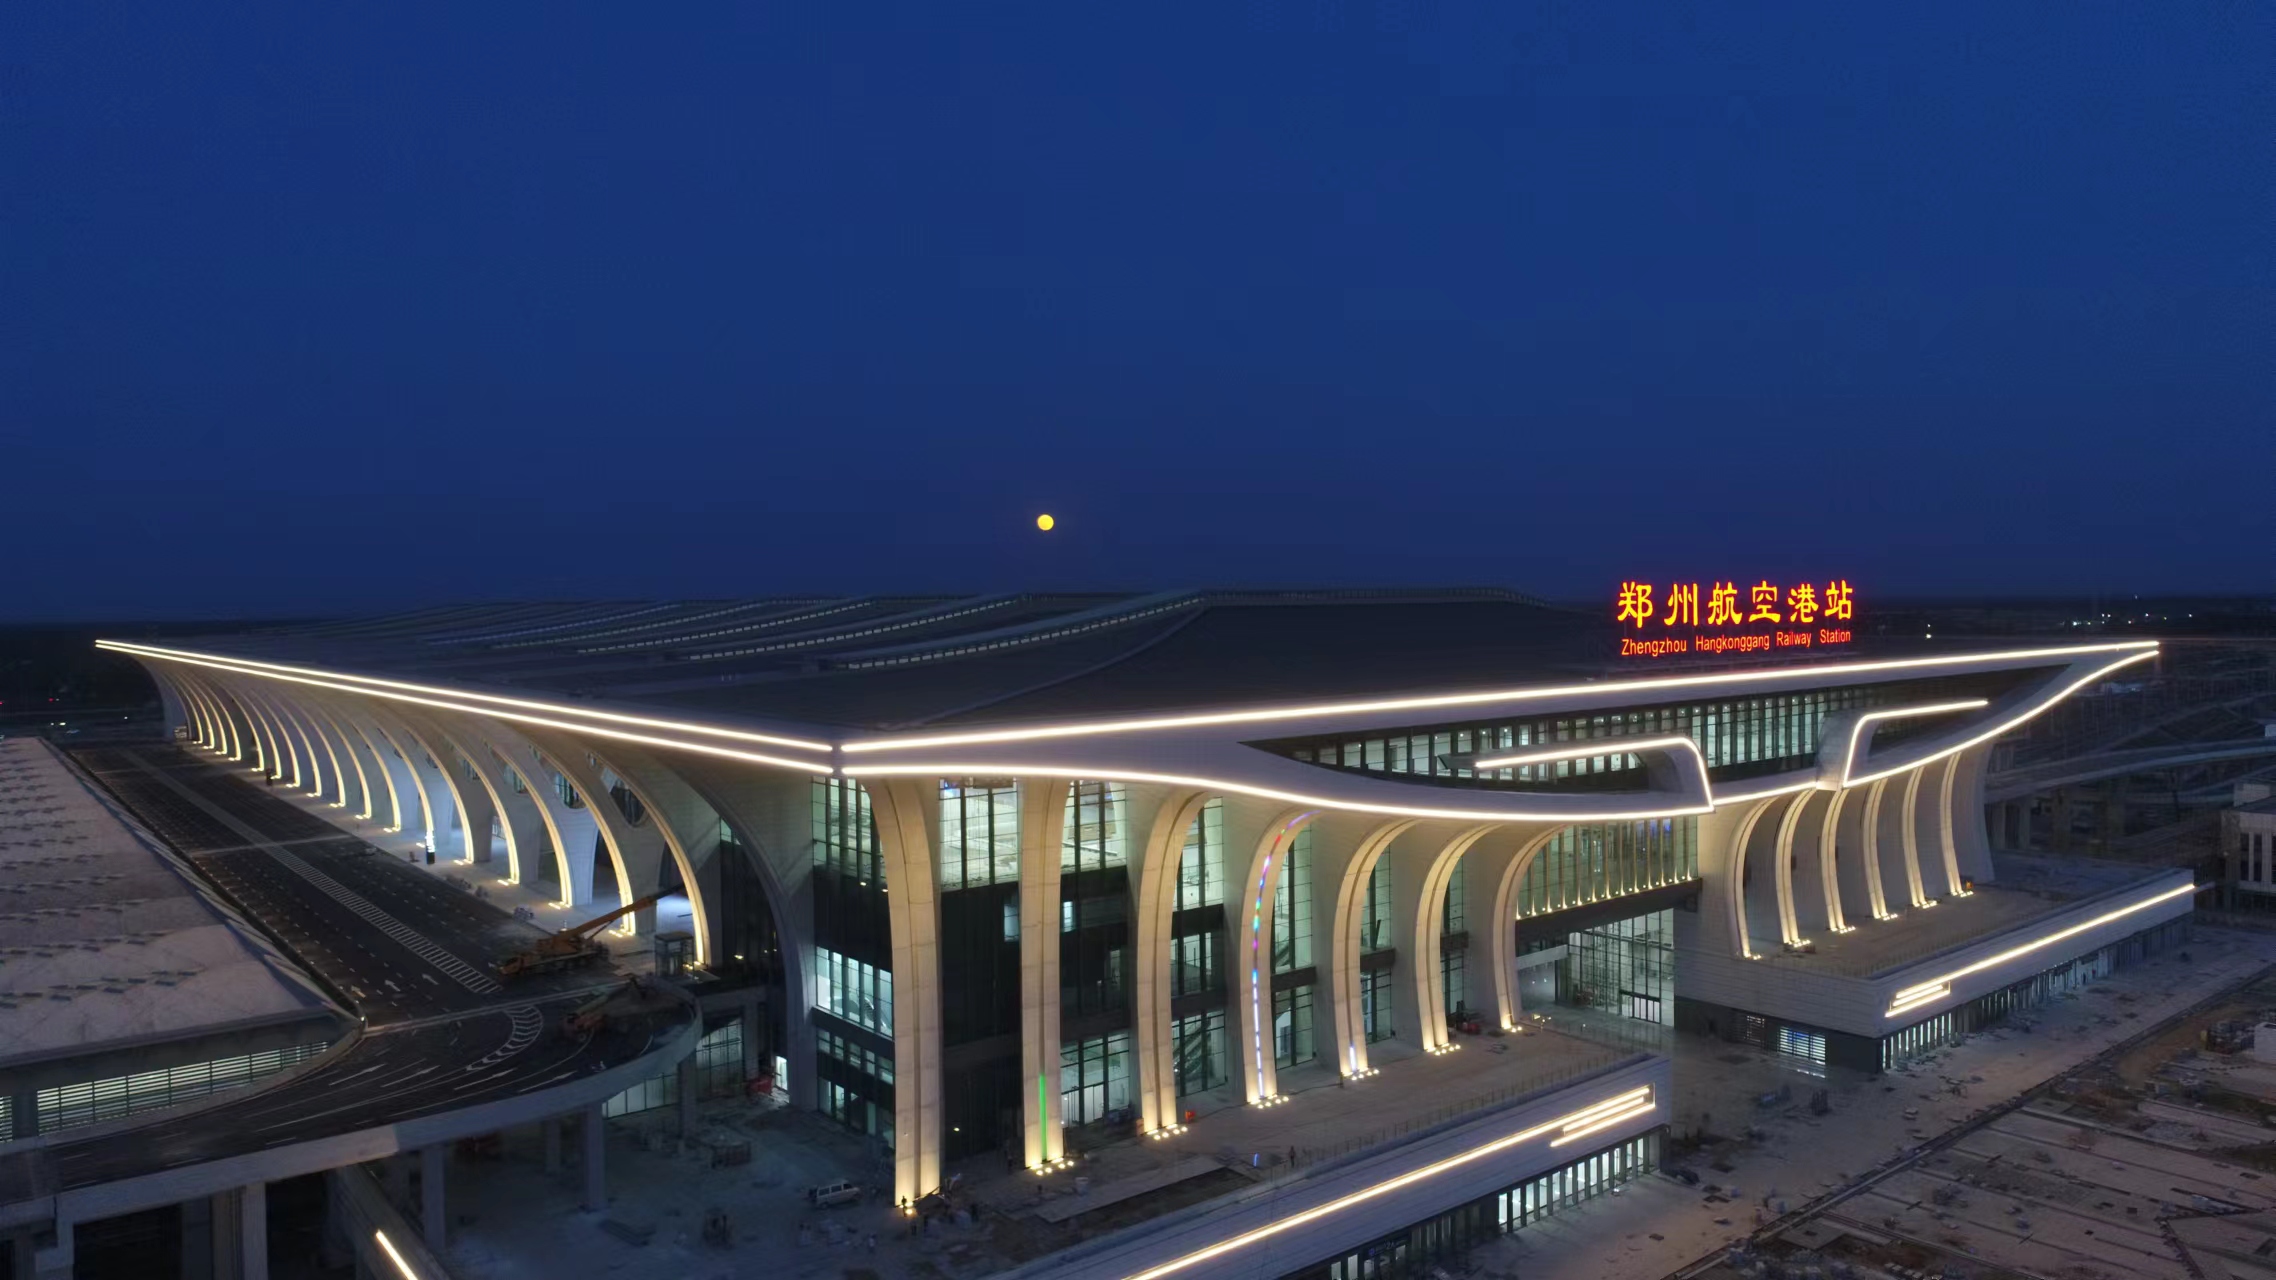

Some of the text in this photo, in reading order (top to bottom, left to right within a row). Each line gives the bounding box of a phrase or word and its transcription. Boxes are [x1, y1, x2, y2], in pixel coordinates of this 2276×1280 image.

[1617, 580, 1853, 628] 郑州航空港站
[1621, 628, 1851, 657] Zhengzhou Hangkonggang Railway Station
